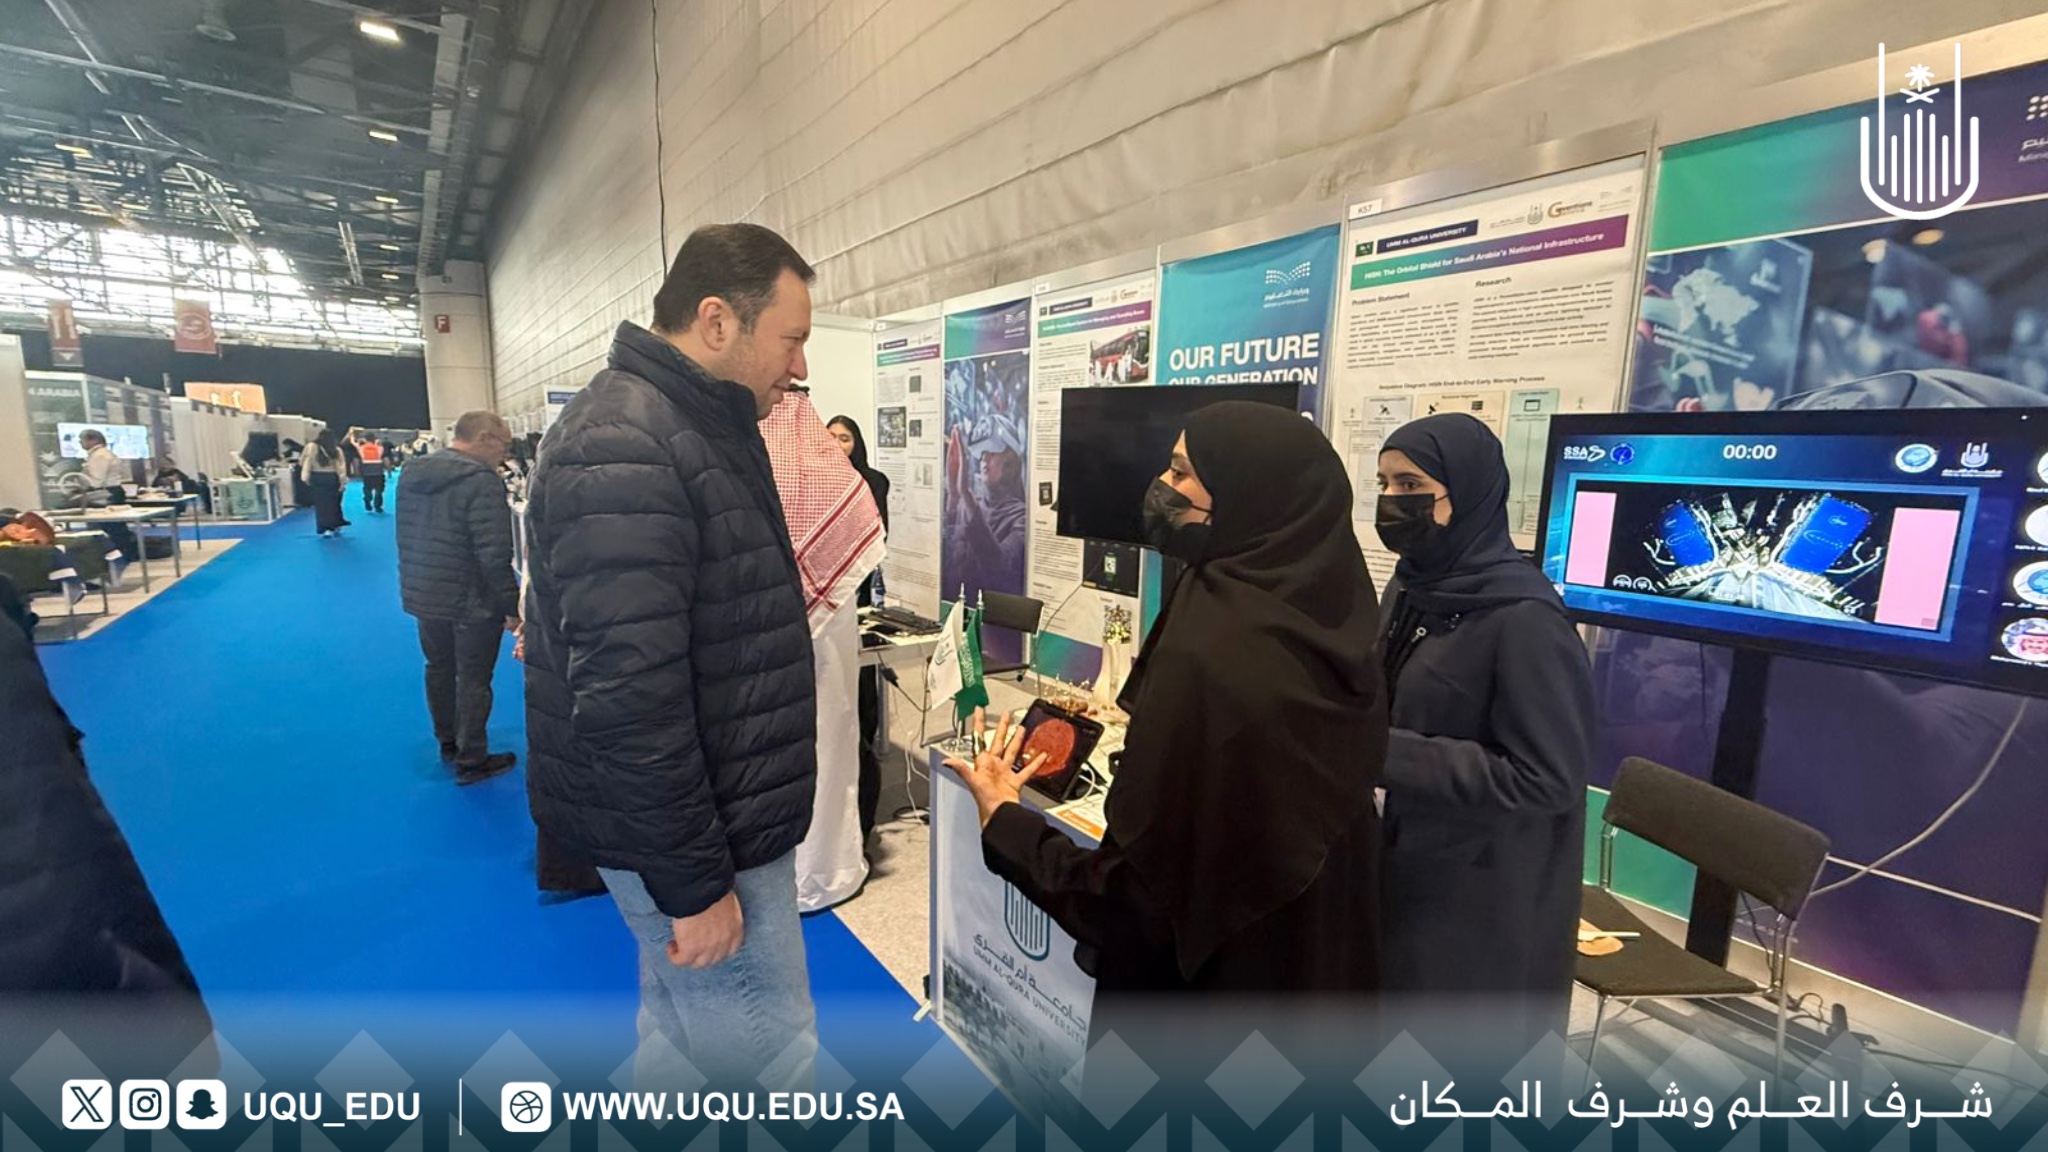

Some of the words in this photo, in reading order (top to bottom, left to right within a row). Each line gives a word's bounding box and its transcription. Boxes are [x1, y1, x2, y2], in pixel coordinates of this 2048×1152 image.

[1386, 239, 1402, 249] UMM
[1429, 226, 1468, 240] UNIVERSITY
[1453, 252, 1475, 265] Saudi
[1508, 240, 1543, 257] National
[1543, 232, 1605, 250] Infrastructure
[1475, 276, 1512, 288] Research
[437, 316, 447, 328] F
[1169, 345, 1215, 371] OUR
[1220, 332, 1320, 366] FUTURE
[1204, 366, 1318, 386] GENERATION
[1723, 444, 1777, 460] 00:00
[973, 944, 992, 968] UMM
[993, 963, 1030, 1001] AL-QURA
[1032, 996, 1087, 1047] UNIVERSITY
